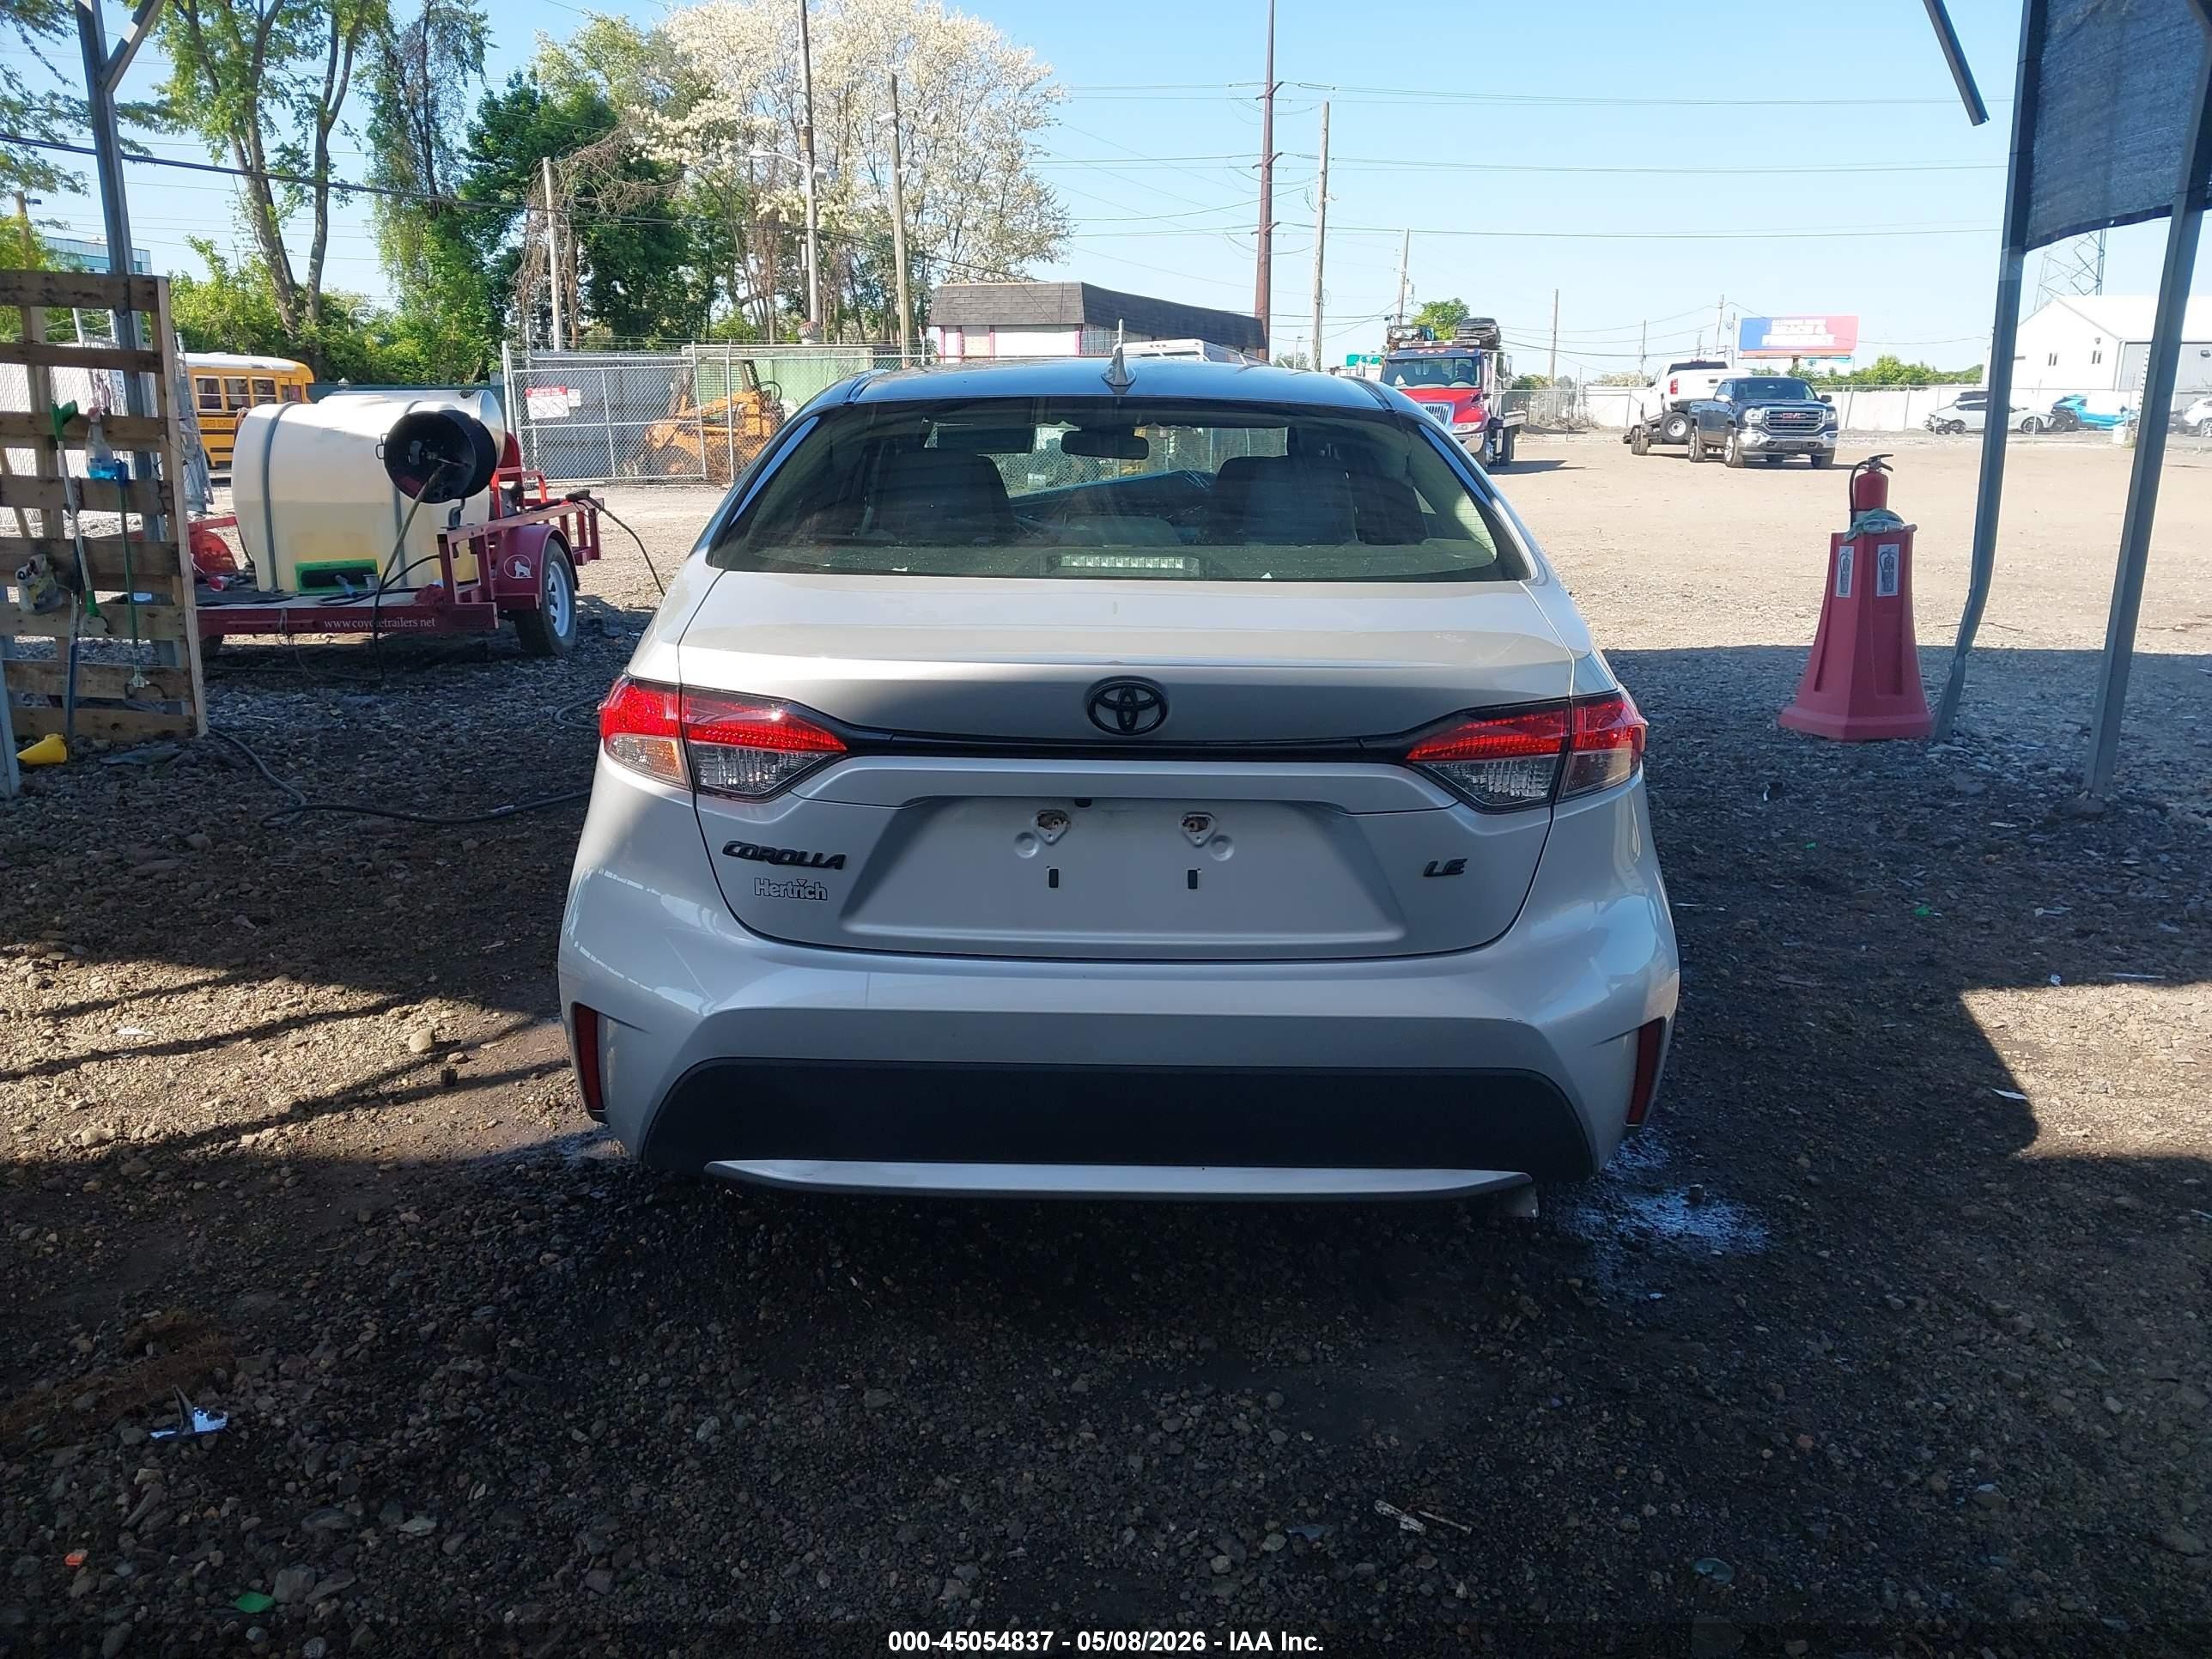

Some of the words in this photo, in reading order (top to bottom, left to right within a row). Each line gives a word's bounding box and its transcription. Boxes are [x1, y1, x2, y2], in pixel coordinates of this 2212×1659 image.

[324, 617, 435, 629] www.coyoetrailers.net
[722, 841, 846, 870] COROLLA
[1423, 858, 1468, 877] LE
[754, 878, 828, 901] Hertrich
